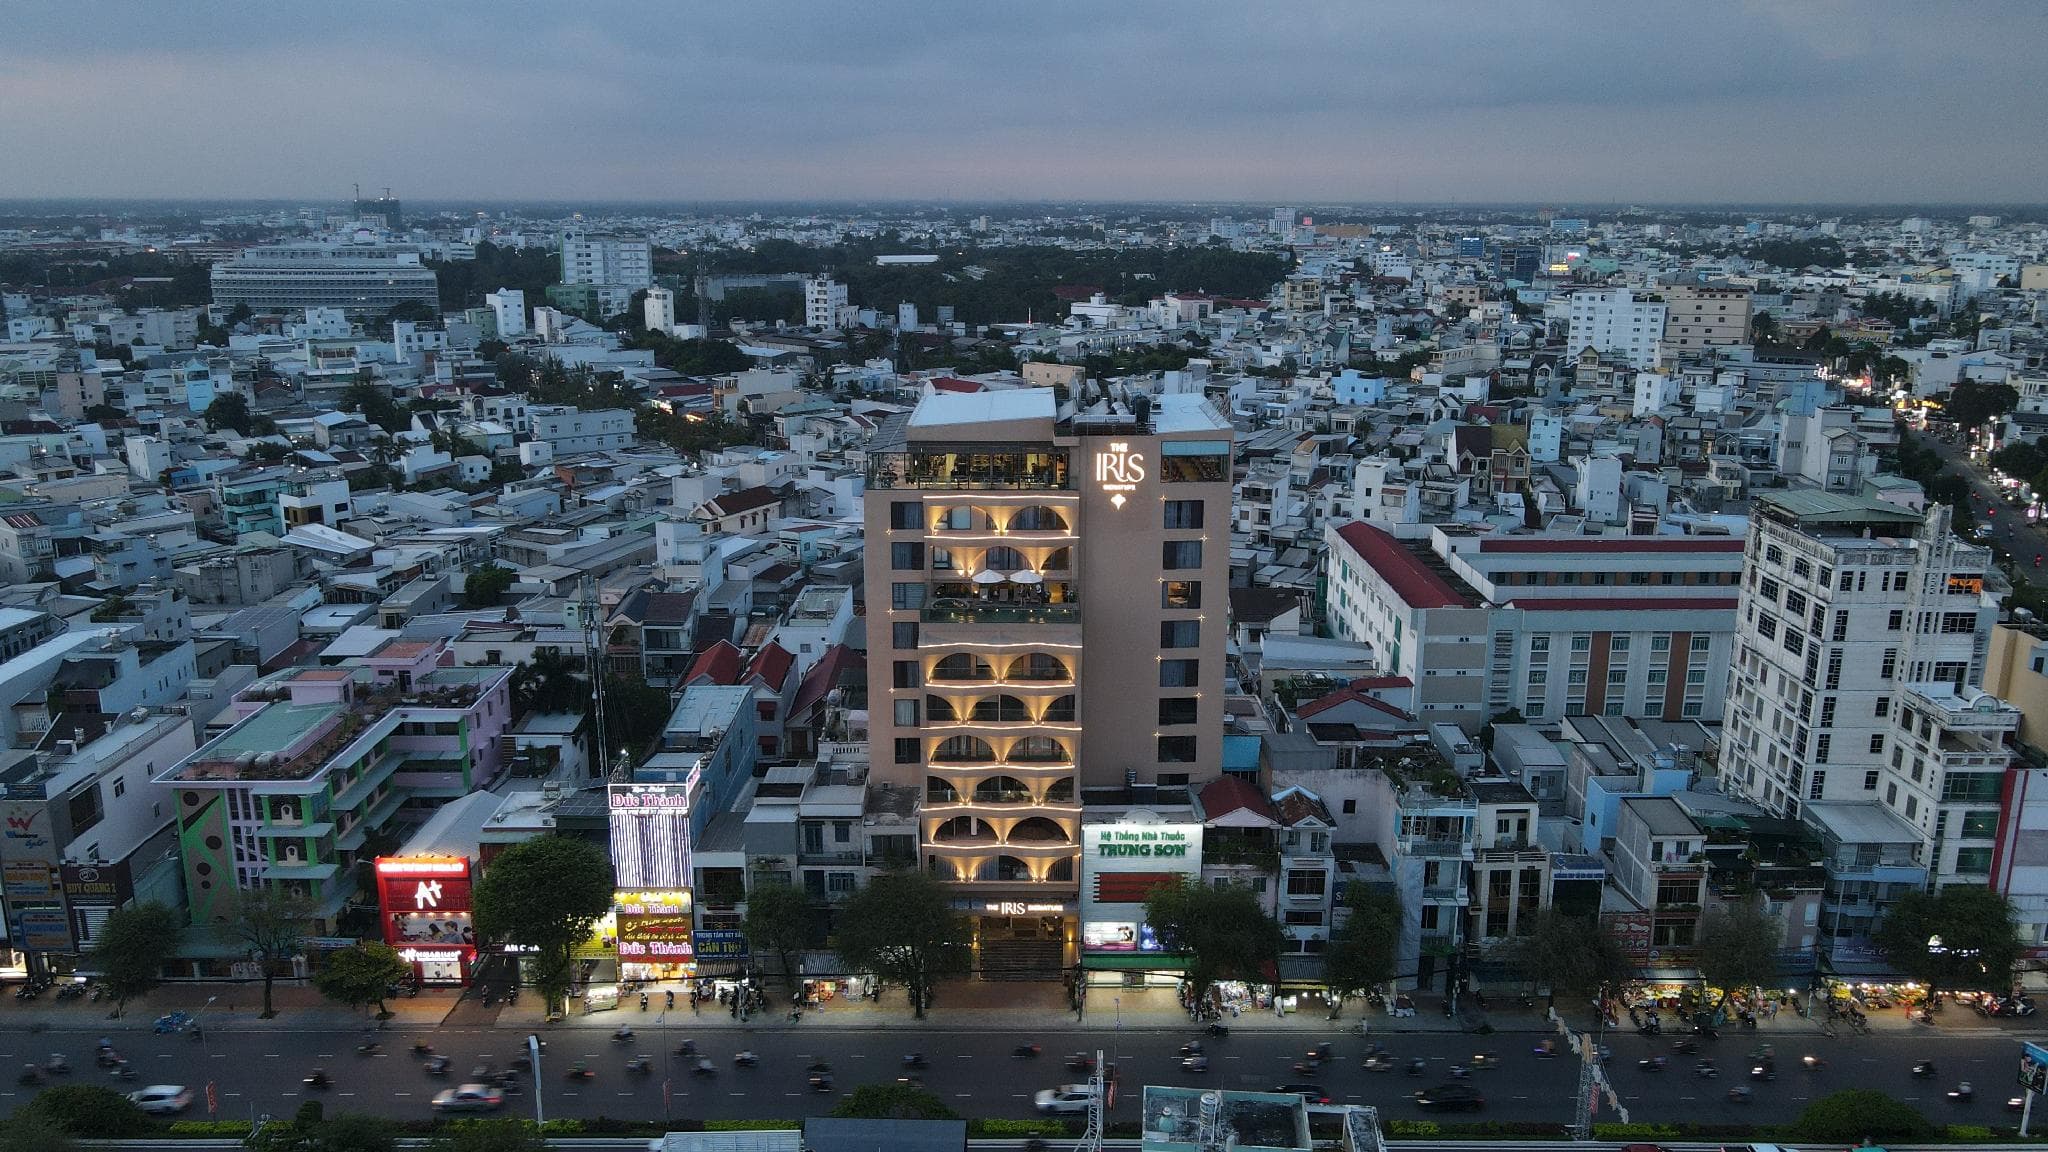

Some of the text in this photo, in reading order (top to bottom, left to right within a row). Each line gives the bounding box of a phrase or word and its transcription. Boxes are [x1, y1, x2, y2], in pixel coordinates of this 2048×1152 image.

[1110, 443, 1128, 452] THE
[1096, 453, 1145, 482] IRIS
[1100, 830, 1185, 841] Hệ Thống Nhà Thuốc
[1098, 844, 1151, 856] TRUNG
[414, 880, 442, 909] A+
[1001, 902, 1026, 915] IRIS
